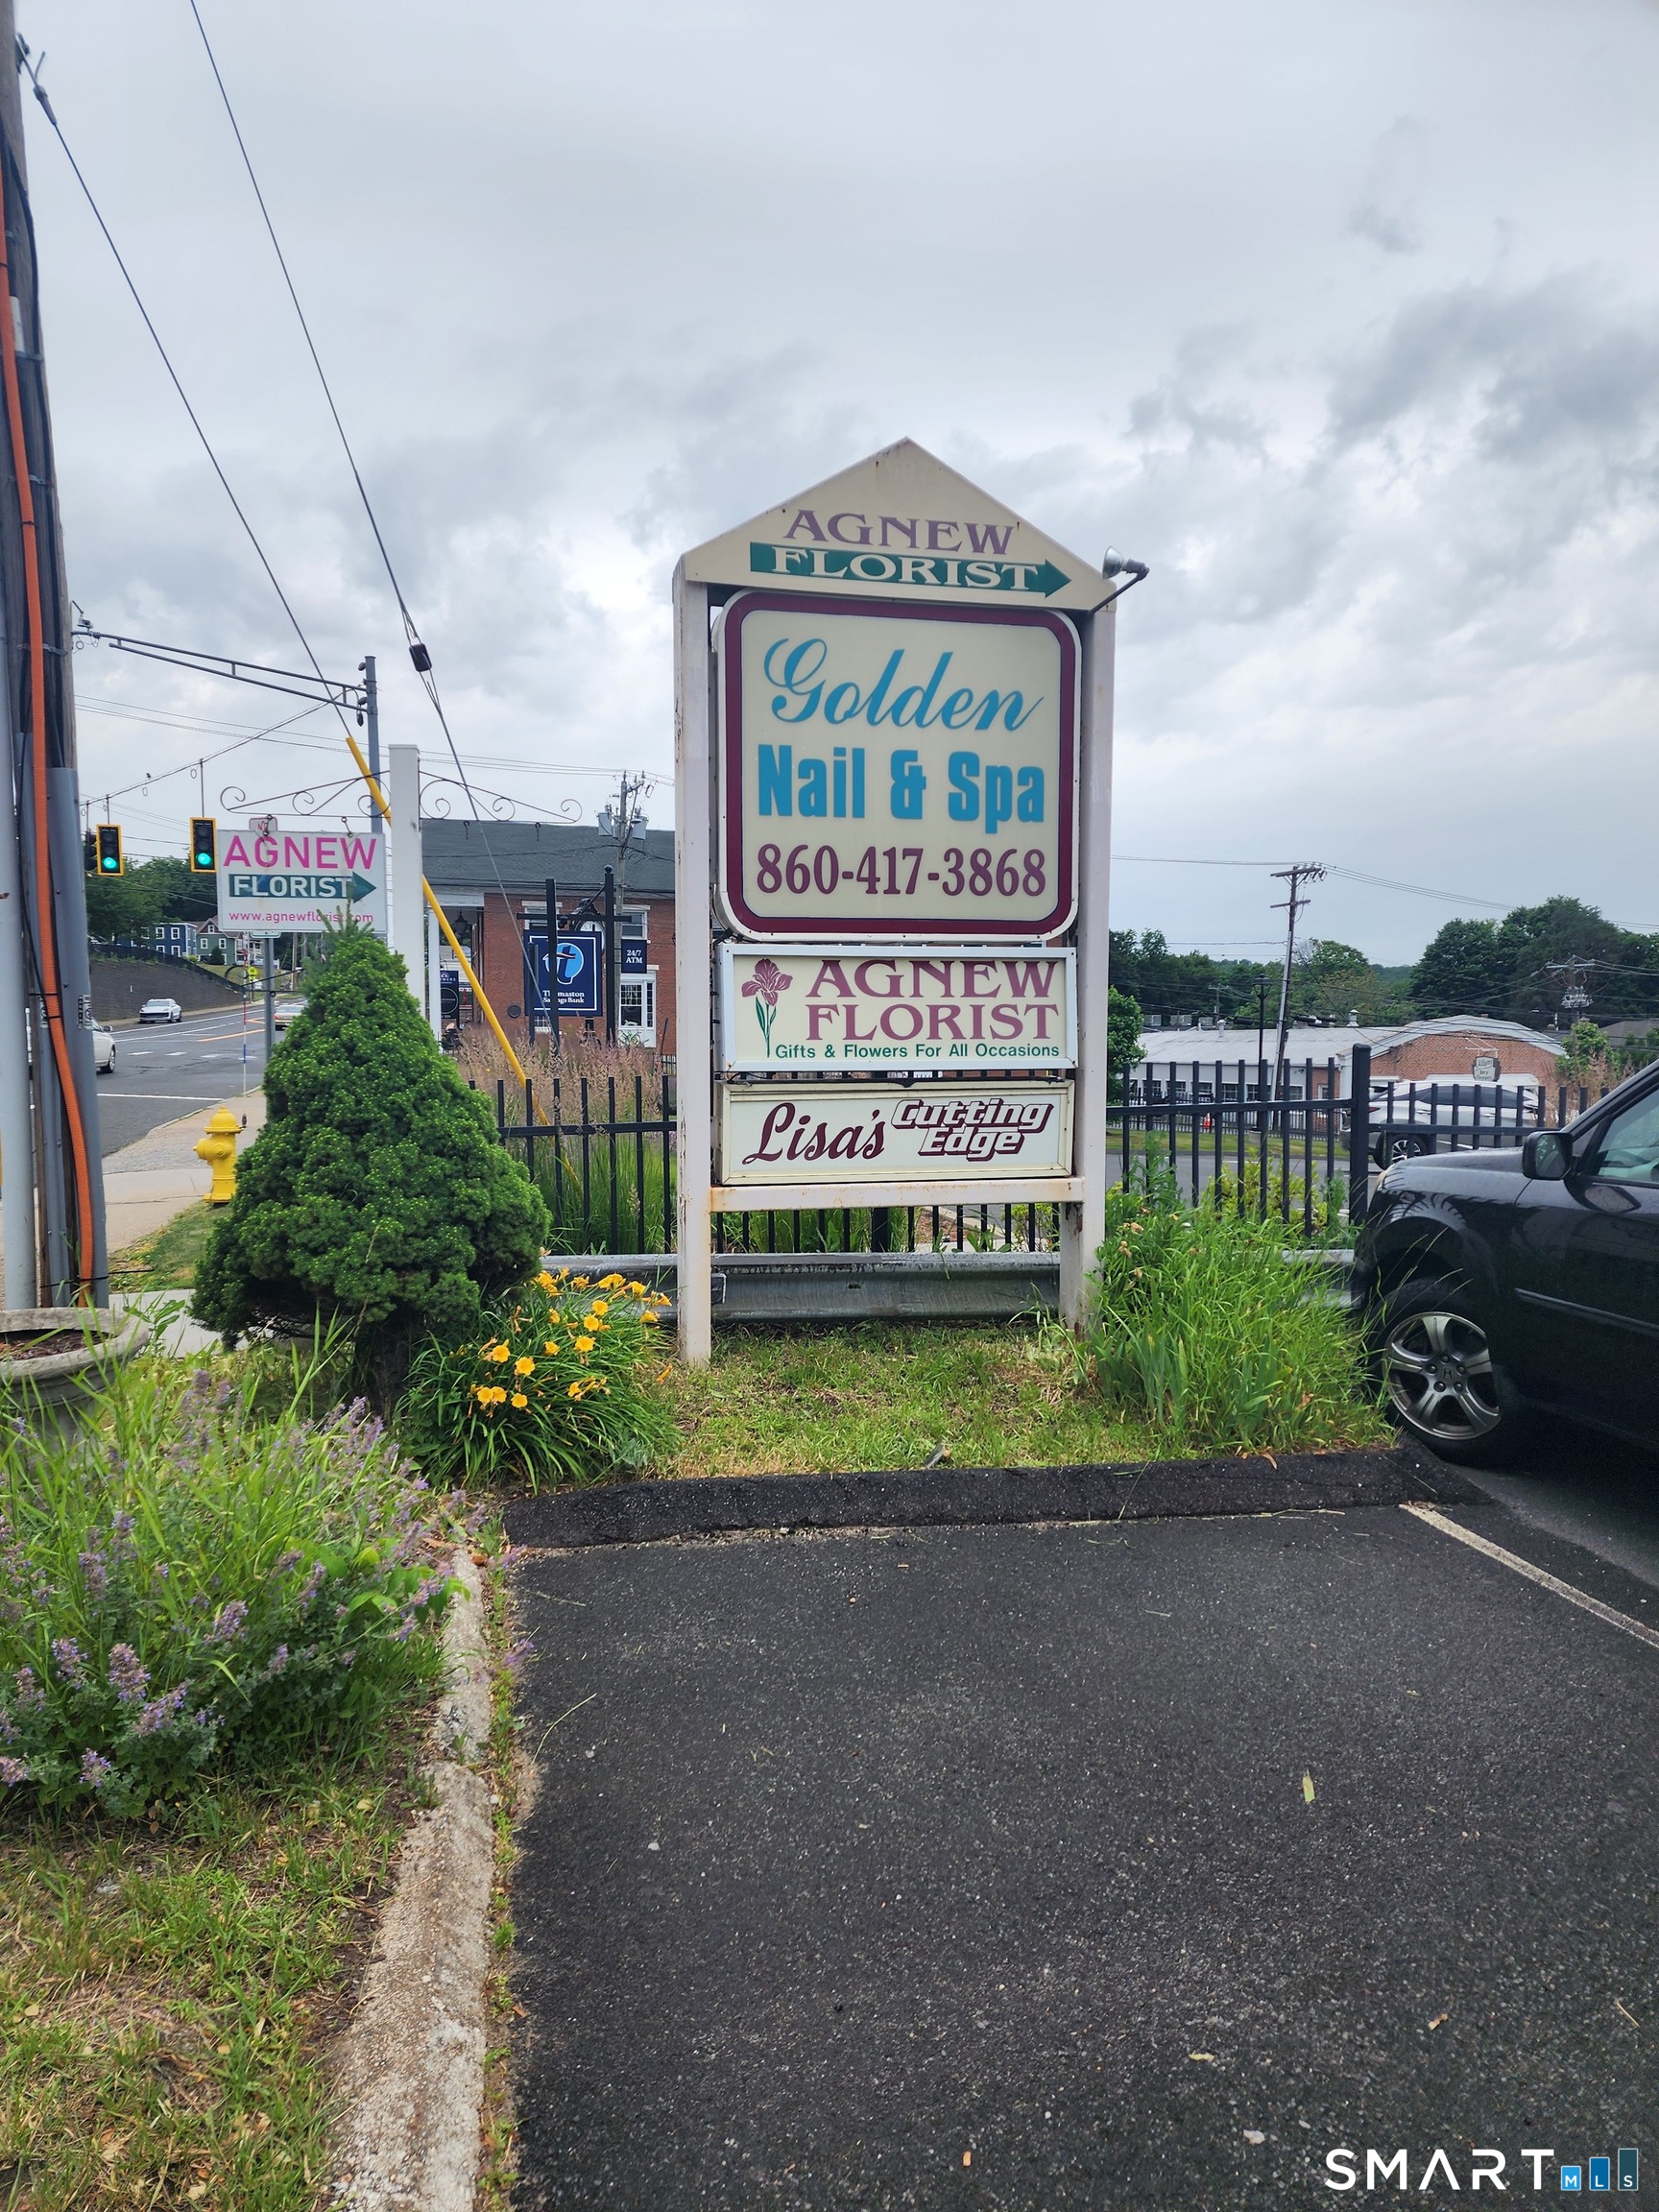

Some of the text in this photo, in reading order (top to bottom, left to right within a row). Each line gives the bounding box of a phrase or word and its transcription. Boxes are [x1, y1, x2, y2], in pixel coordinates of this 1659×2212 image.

[782, 509, 1014, 555] AGNEW
[772, 545, 1039, 591] FLORIST
[763, 637, 1046, 733] Golden
[757, 743, 1046, 834] Nail & Spa
[223, 834, 377, 870] AGNEW
[757, 843, 1046, 898] 860-417-3868
[233, 875, 353, 899] FLORIST
[228, 910, 373, 925] www.agnewflois.om
[805, 959, 1060, 999] AGNEW
[805, 1003, 1060, 1042] FLORIST
[775, 1043, 1060, 1059] Gifts & Flowers For All Occasions
[741, 1101, 885, 1166] Lisa's
[891, 1098, 1054, 1134] Cutting
[918, 1124, 1025, 1163] Edge
